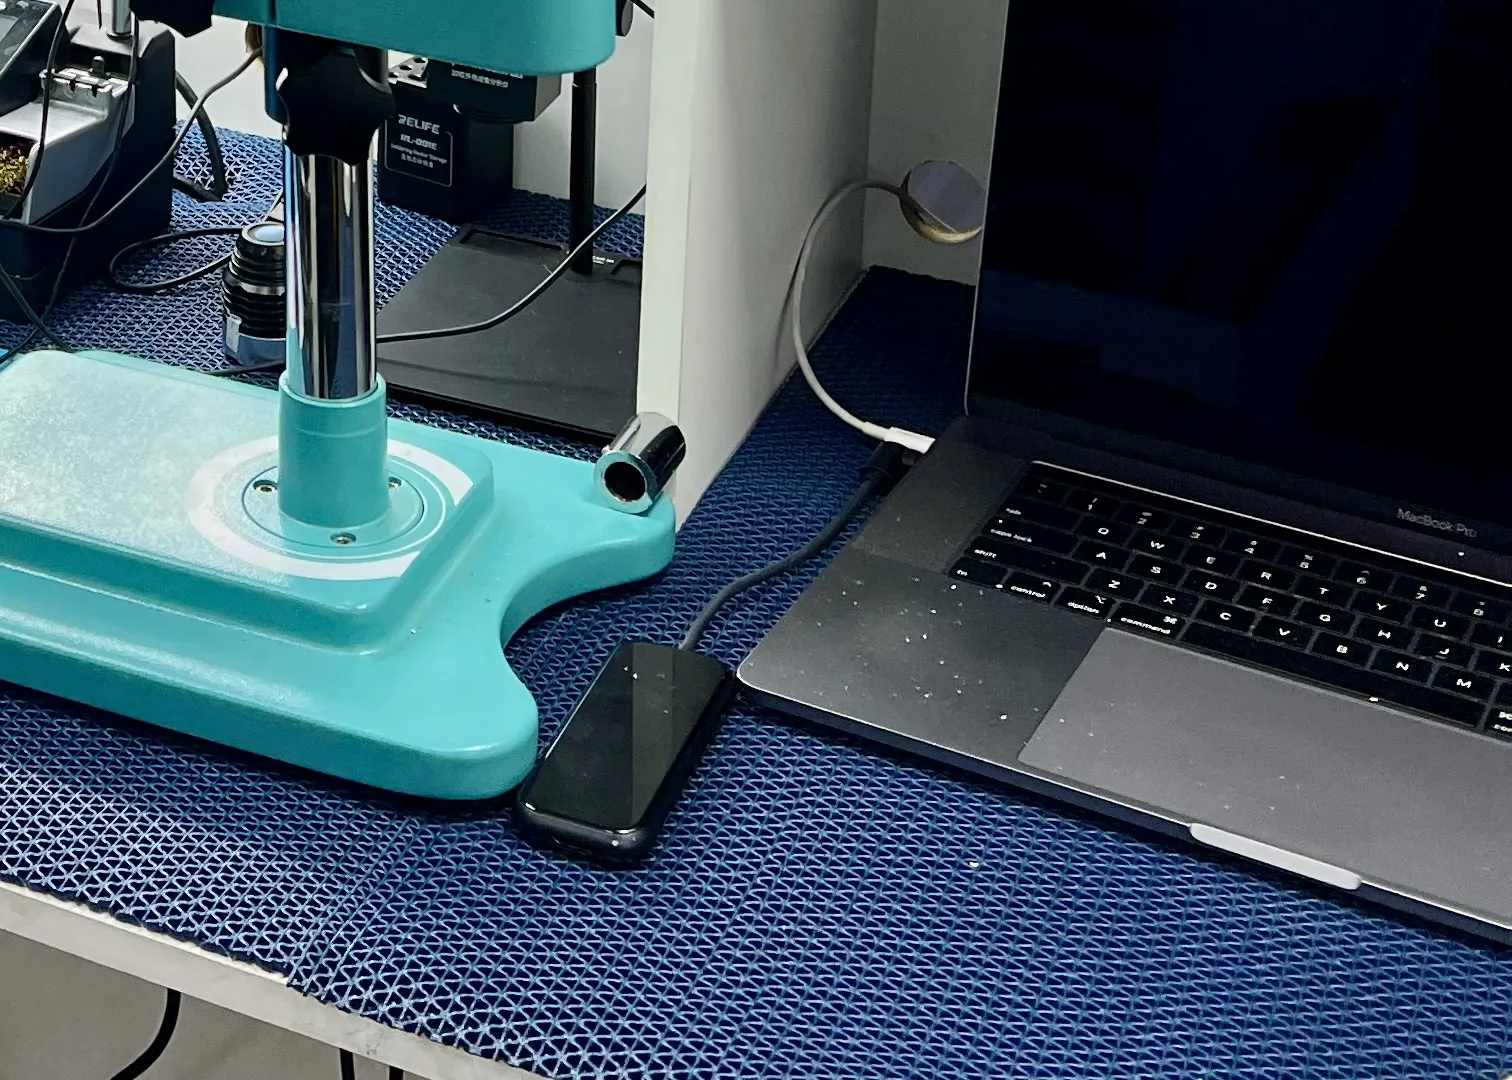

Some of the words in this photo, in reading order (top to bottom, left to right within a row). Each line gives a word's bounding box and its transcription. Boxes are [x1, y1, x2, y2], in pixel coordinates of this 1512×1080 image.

[398, 113, 441, 135] RELIFE
[1397, 507, 1453, 532] MacBook
[1456, 523, 1477, 537] Pro
[1010, 585, 1046, 598] control
[1067, 601, 1099, 614] option
[1120, 617, 1171, 634] command
